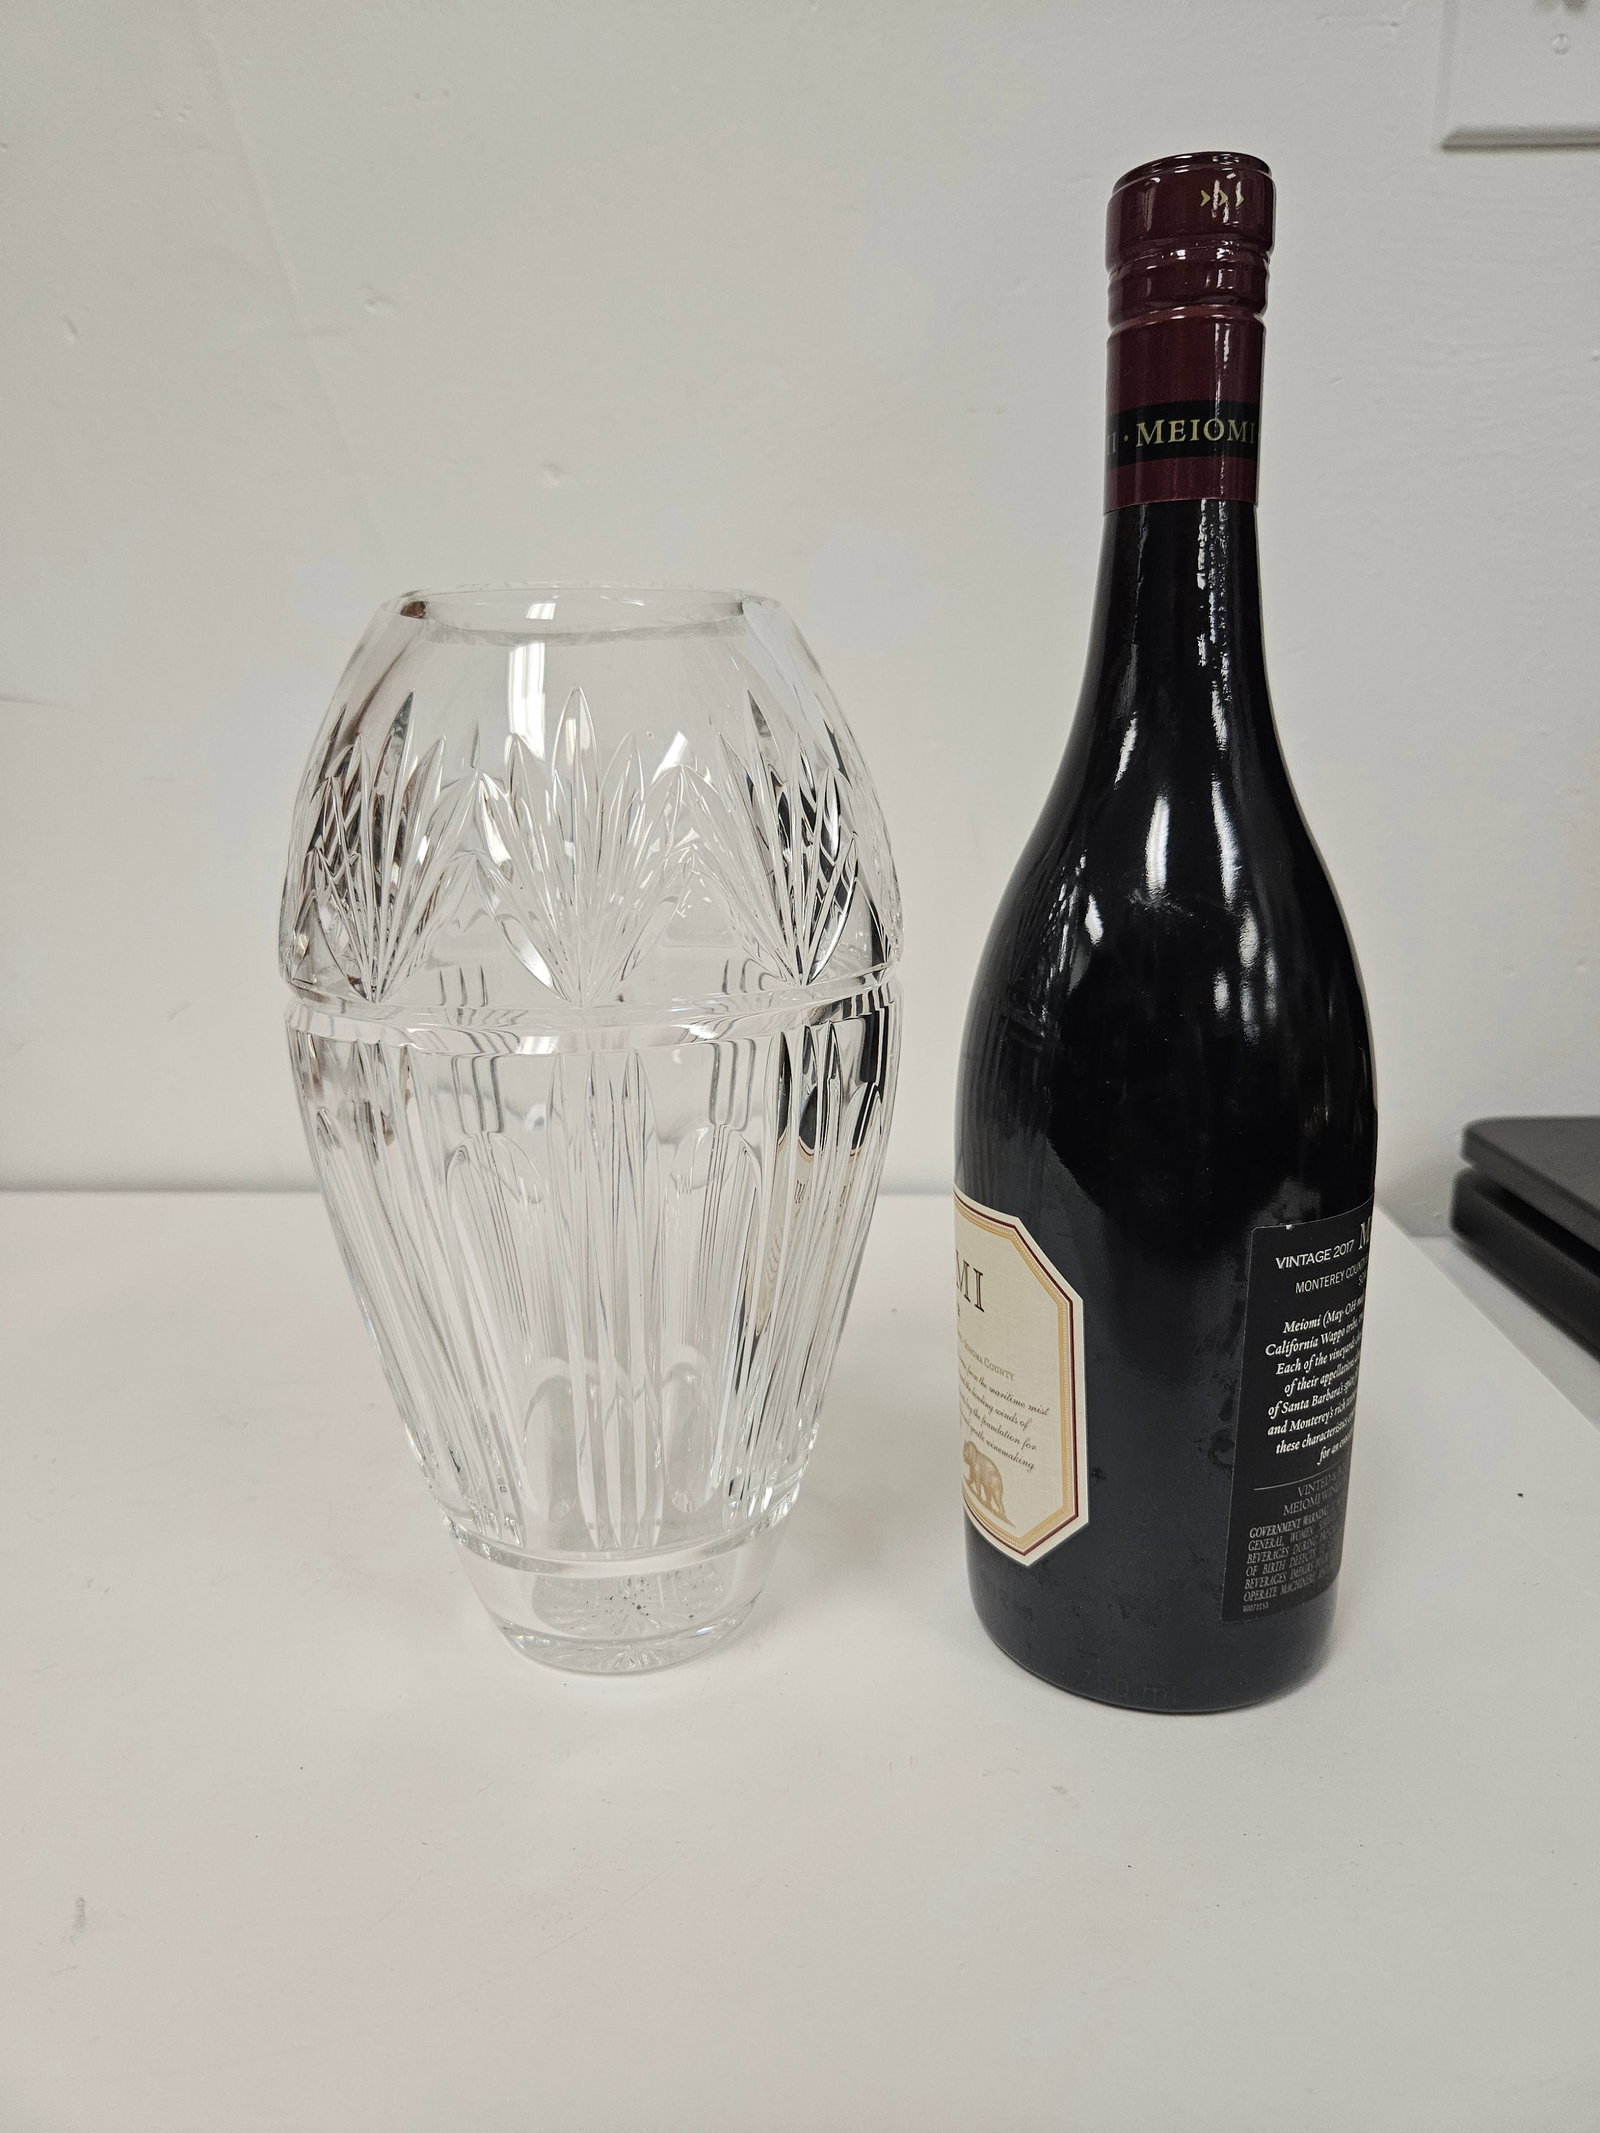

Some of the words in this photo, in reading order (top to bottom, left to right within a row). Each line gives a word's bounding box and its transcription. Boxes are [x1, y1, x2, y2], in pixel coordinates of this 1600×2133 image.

[1135, 418, 1256, 448] MEIOMI
[1275, 1248, 1332, 1270] VINTAGE
[1333, 1239, 1356, 1259] 2017
[1295, 1271, 1345, 1294] MONTEREY
[1283, 1314, 1321, 1334] Meiomi
[1265, 1337, 1319, 1357] California
[1320, 1328, 1346, 1346] Wappo
[1276, 1359, 1301, 1375] Each
[1303, 1353, 1317, 1373] of
[1315, 1352, 1328, 1366] the
[979, 1376, 988, 1389] the
[989, 1386, 1026, 1409] maritime
[1028, 1404, 1050, 1417] mist
[1284, 1378, 1298, 1397] of
[1297, 1375, 1320, 1391] their
[1268, 1400, 1283, 1420] of
[1281, 1399, 1309, 1414] Santa
[1311, 1385, 1343, 1407] Barbara's
[995, 1407, 1018, 1425] winds
[1020, 1417, 1032, 1432] of
[1267, 1420, 1287, 1436] and
[1289, 1407, 1333, 1432] Monterey's
[980, 1414, 1020, 1446] foundation
[1021, 1436, 1037, 1451] for
[985, 1439, 1035, 1473] winemaking
[1275, 1439, 1300, 1454] these
[1317, 1446, 1330, 1465] for
[1283, 1494, 1321, 1516] MEIOMI
[1249, 1519, 1302, 1539] GOVERNMENT
[1246, 1546, 1290, 1565] BEVERAGES
[1245, 1565, 1258, 1577] OF
[1262, 1560, 1286, 1575] BIRTH
[1244, 1571, 1287, 1590] BEVERAGES
[1243, 1585, 1277, 1602] OPERATE
